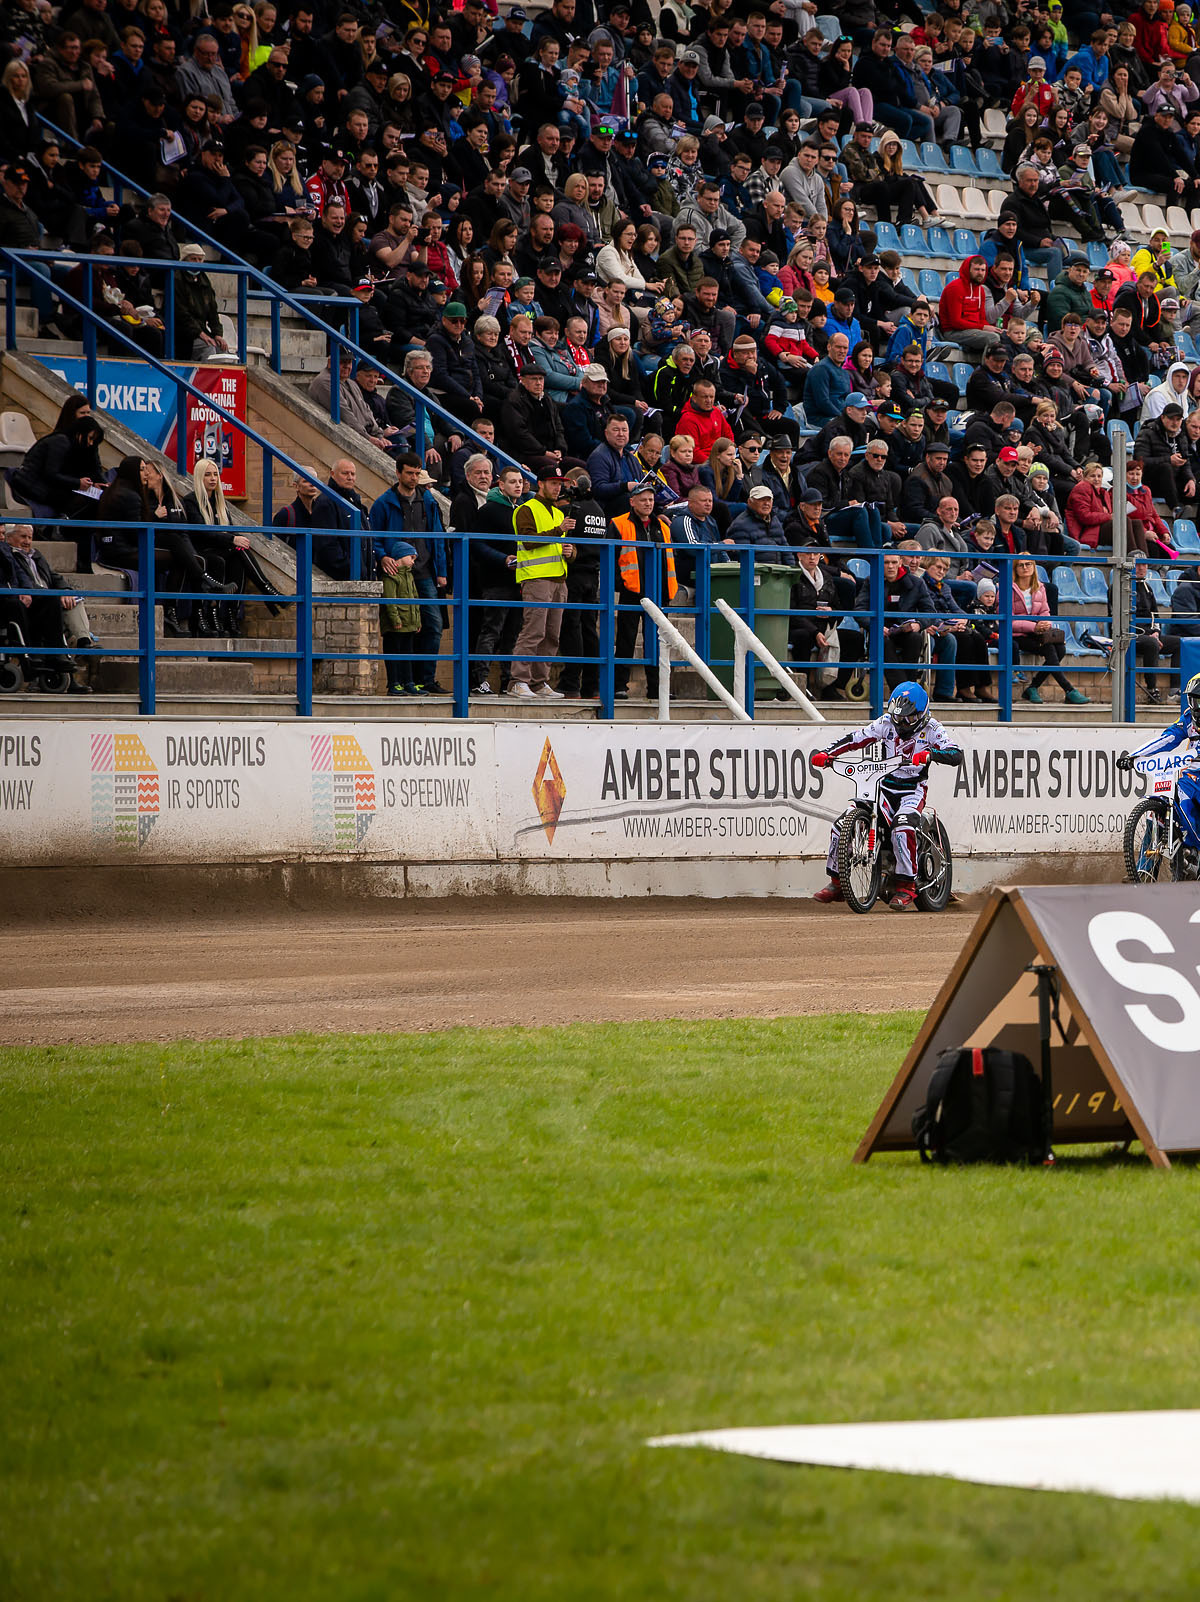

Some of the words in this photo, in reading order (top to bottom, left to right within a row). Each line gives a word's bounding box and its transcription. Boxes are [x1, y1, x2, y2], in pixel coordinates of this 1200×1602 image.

[74, 382, 162, 412] OKKER
[222, 378, 237, 392] THE
[166, 736, 266, 767] DAUGAVPILS
[381, 736, 476, 767] DAUGAVPILS
[601, 749, 700, 800] AMBER
[709, 749, 825, 800] STUDIOS
[857, 763, 888, 772] OPTIBET
[953, 750, 1041, 798] AMBER
[1048, 750, 1148, 798] STUDIOS
[167, 780, 180, 808] IR
[185, 780, 240, 808] SPORTS
[382, 778, 395, 806] IS
[400, 778, 470, 806] SPEEDWAY
[623, 817, 808, 838] WWW.AMBER-STUDIOS.COM
